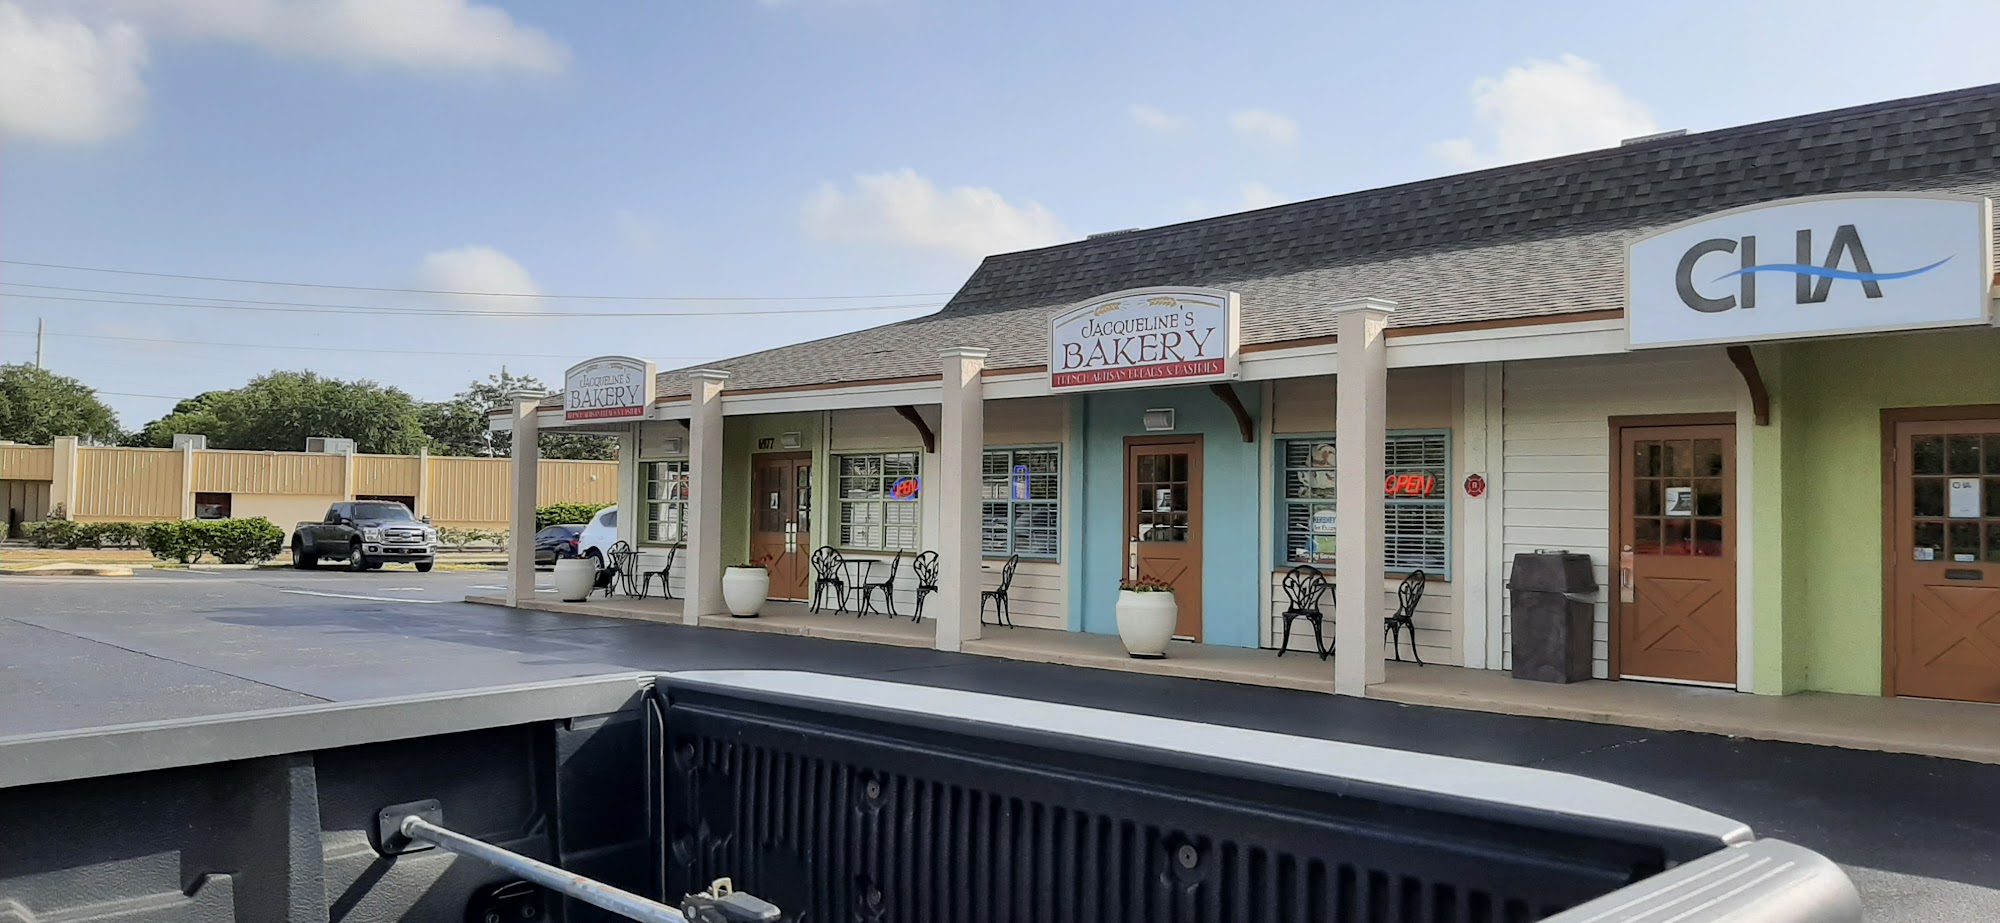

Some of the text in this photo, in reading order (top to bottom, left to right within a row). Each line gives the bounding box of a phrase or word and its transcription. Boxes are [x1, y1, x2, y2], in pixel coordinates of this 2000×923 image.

[1675, 224, 1883, 313] CHA
[1081, 305, 1195, 338] JACQUELINE'S
[1062, 327, 1216, 370] BAKERY
[580, 368, 631, 388] JACQUELINE'S
[1057, 374, 1089, 386] FRENCH
[1092, 370, 1126, 382] ARTISAN
[1128, 365, 1163, 379] BREADS
[1175, 361, 1218, 375] PASTRIES
[570, 385, 640, 409] BAKERY
[1385, 475, 1435, 497] OPEN
